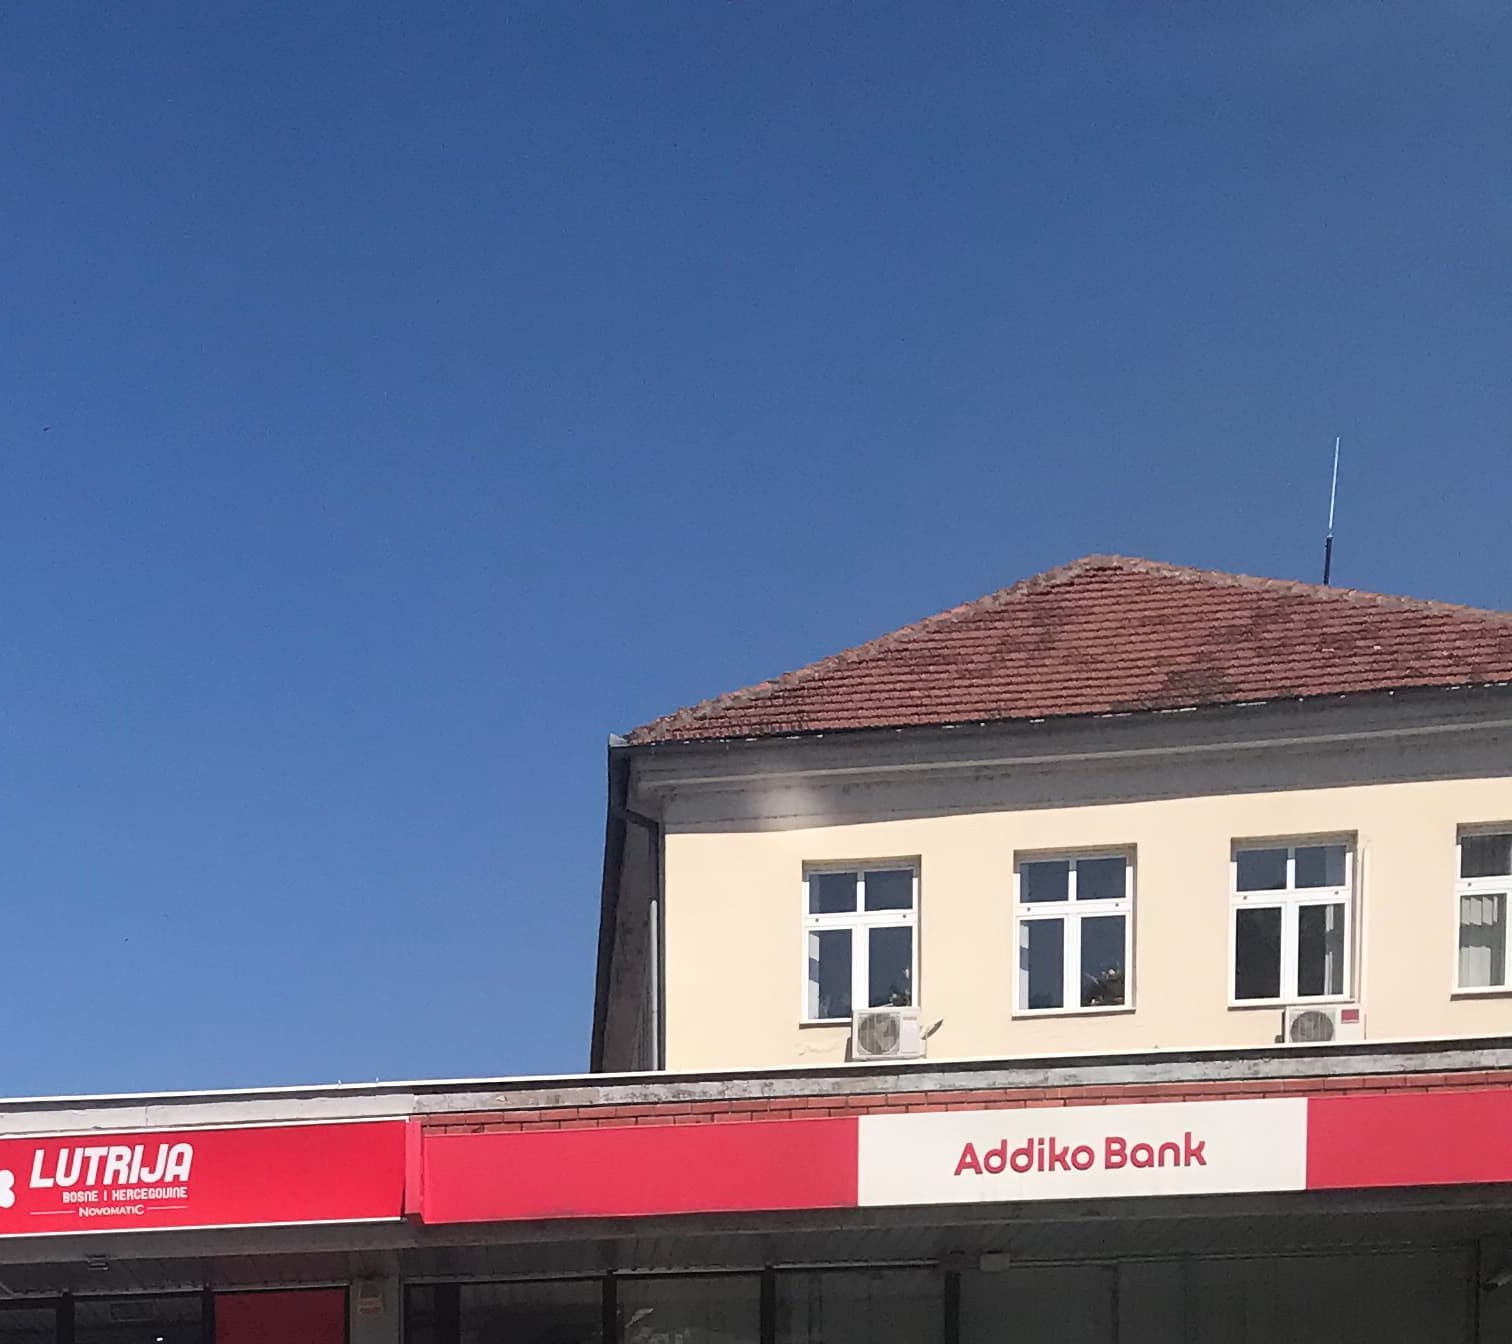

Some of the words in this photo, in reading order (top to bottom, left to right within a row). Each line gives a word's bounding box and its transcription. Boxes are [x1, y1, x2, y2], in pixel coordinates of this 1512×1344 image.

[29, 1143, 193, 1188] LUTRIJA
[953, 1138, 1095, 1177] Addiko
[1104, 1132, 1206, 1170] Bank
[63, 1190, 98, 1203] BOSNE
